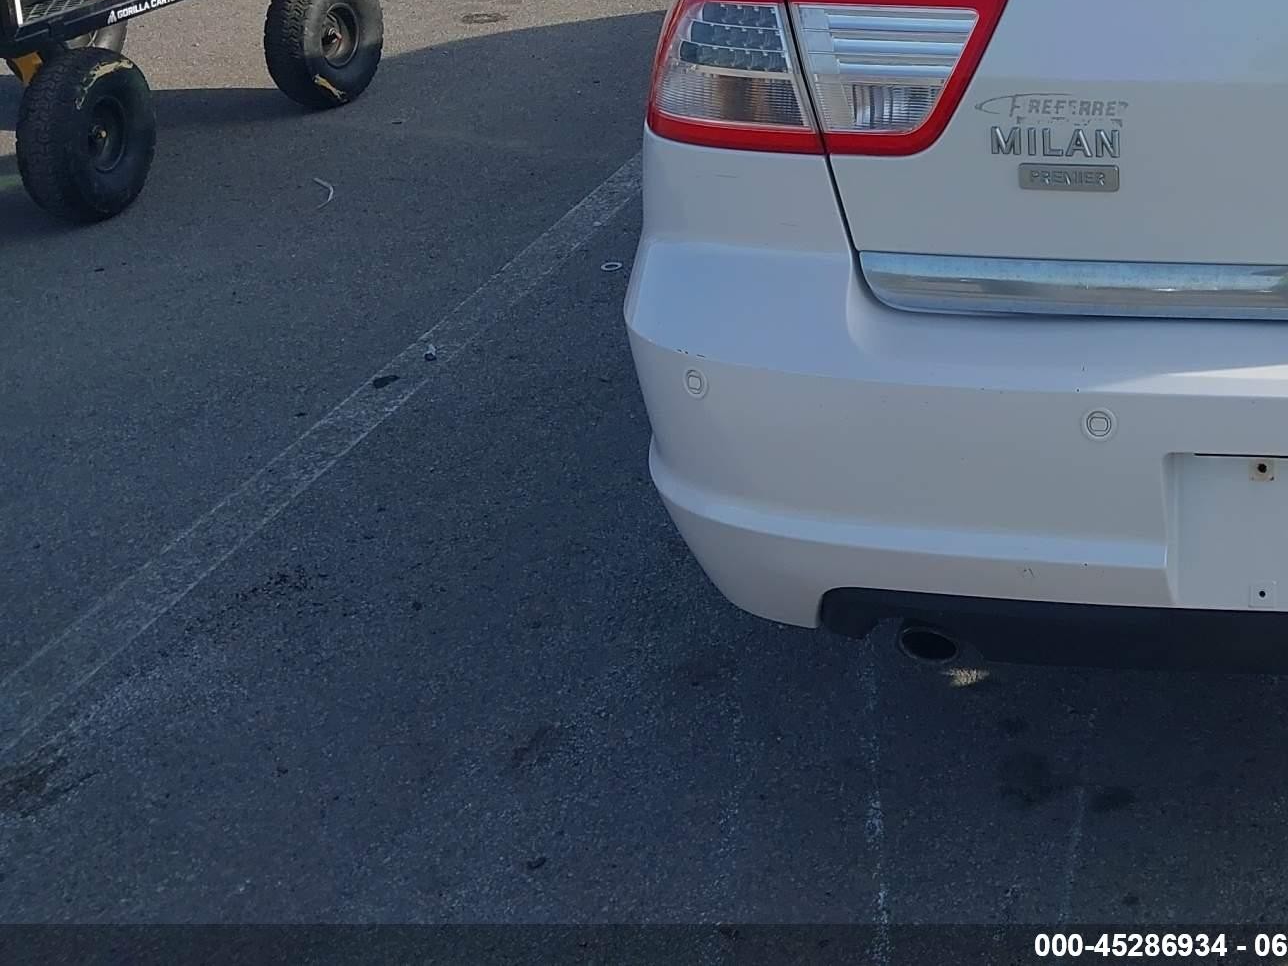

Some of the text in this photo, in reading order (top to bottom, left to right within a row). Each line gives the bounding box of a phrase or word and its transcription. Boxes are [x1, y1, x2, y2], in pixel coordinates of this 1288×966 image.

[117, 1, 150, 19] GORILLA
[991, 126, 1121, 158] MILAN
[1030, 169, 1106, 186] PREMIER
